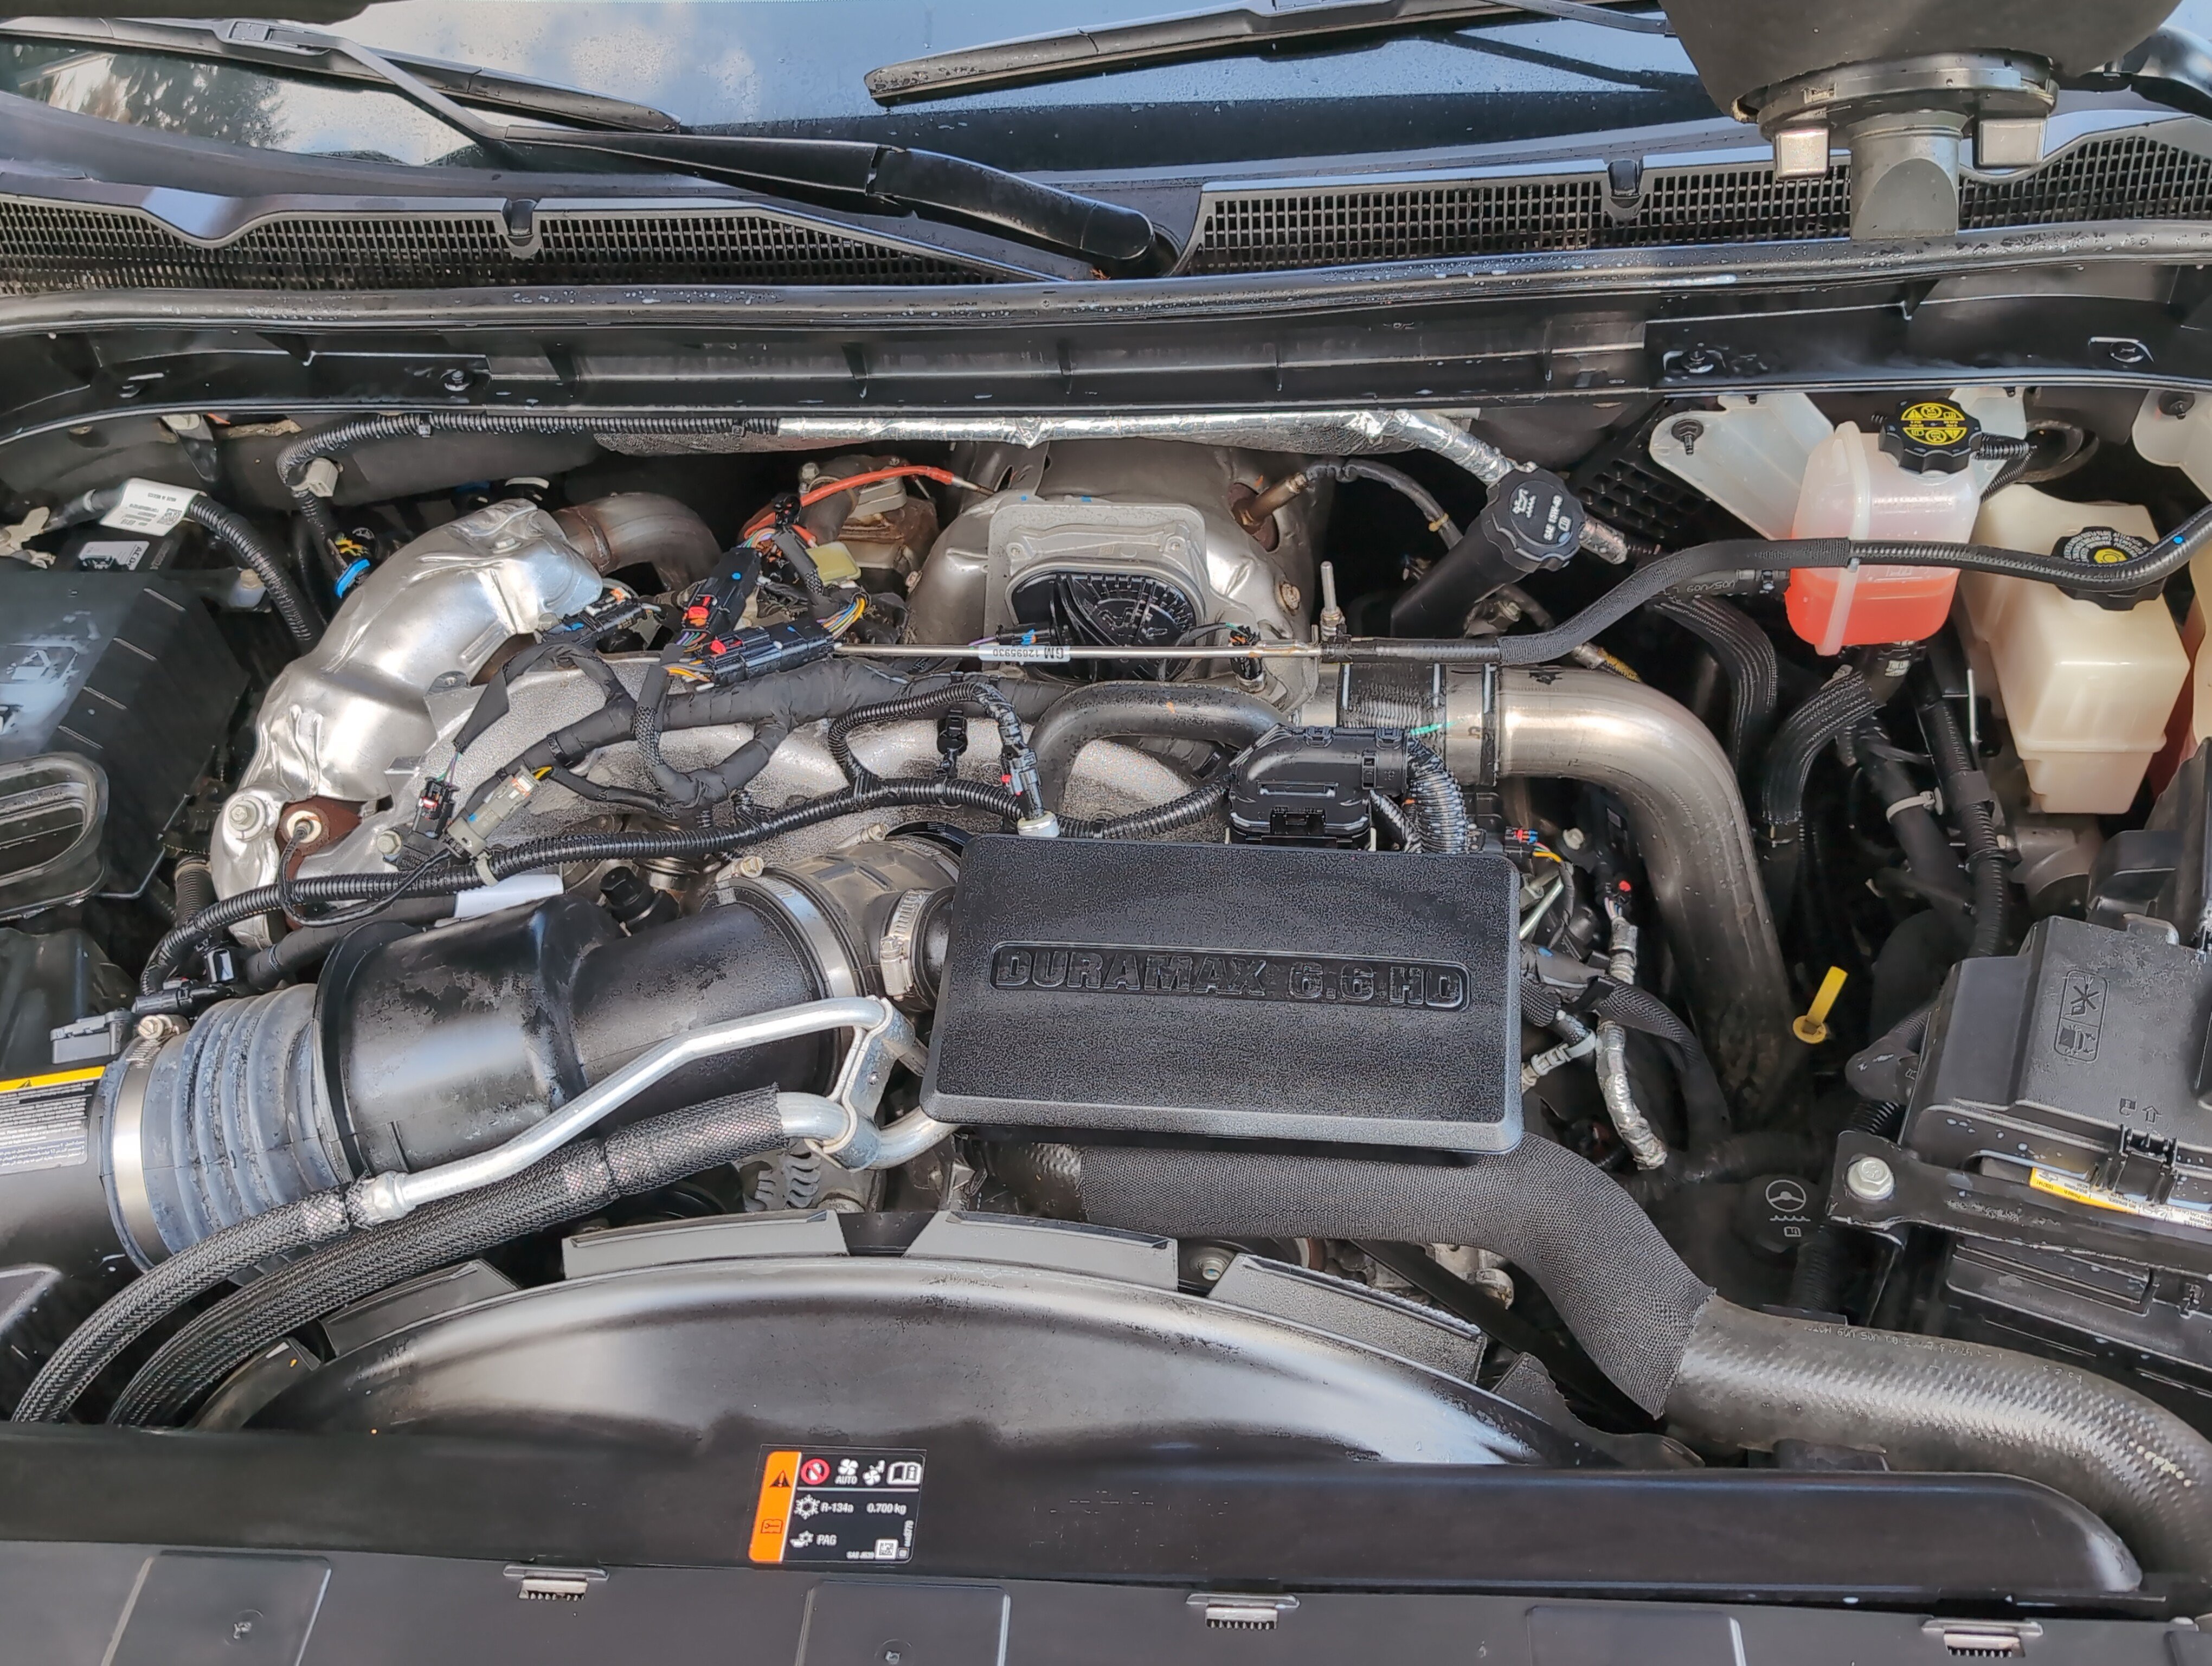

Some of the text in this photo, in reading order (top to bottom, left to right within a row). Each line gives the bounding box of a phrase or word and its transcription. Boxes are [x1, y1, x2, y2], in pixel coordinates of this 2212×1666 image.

[1543, 523, 1556, 541] SAE
[1044, 648, 1064, 659] GM
[996, 950, 1465, 1010] DURAMAX 6.6 HD
[835, 1475, 858, 1485] AUTO
[820, 1502, 907, 1516] R-134a 0.700 kg
[816, 1534, 838, 1546] PAG
